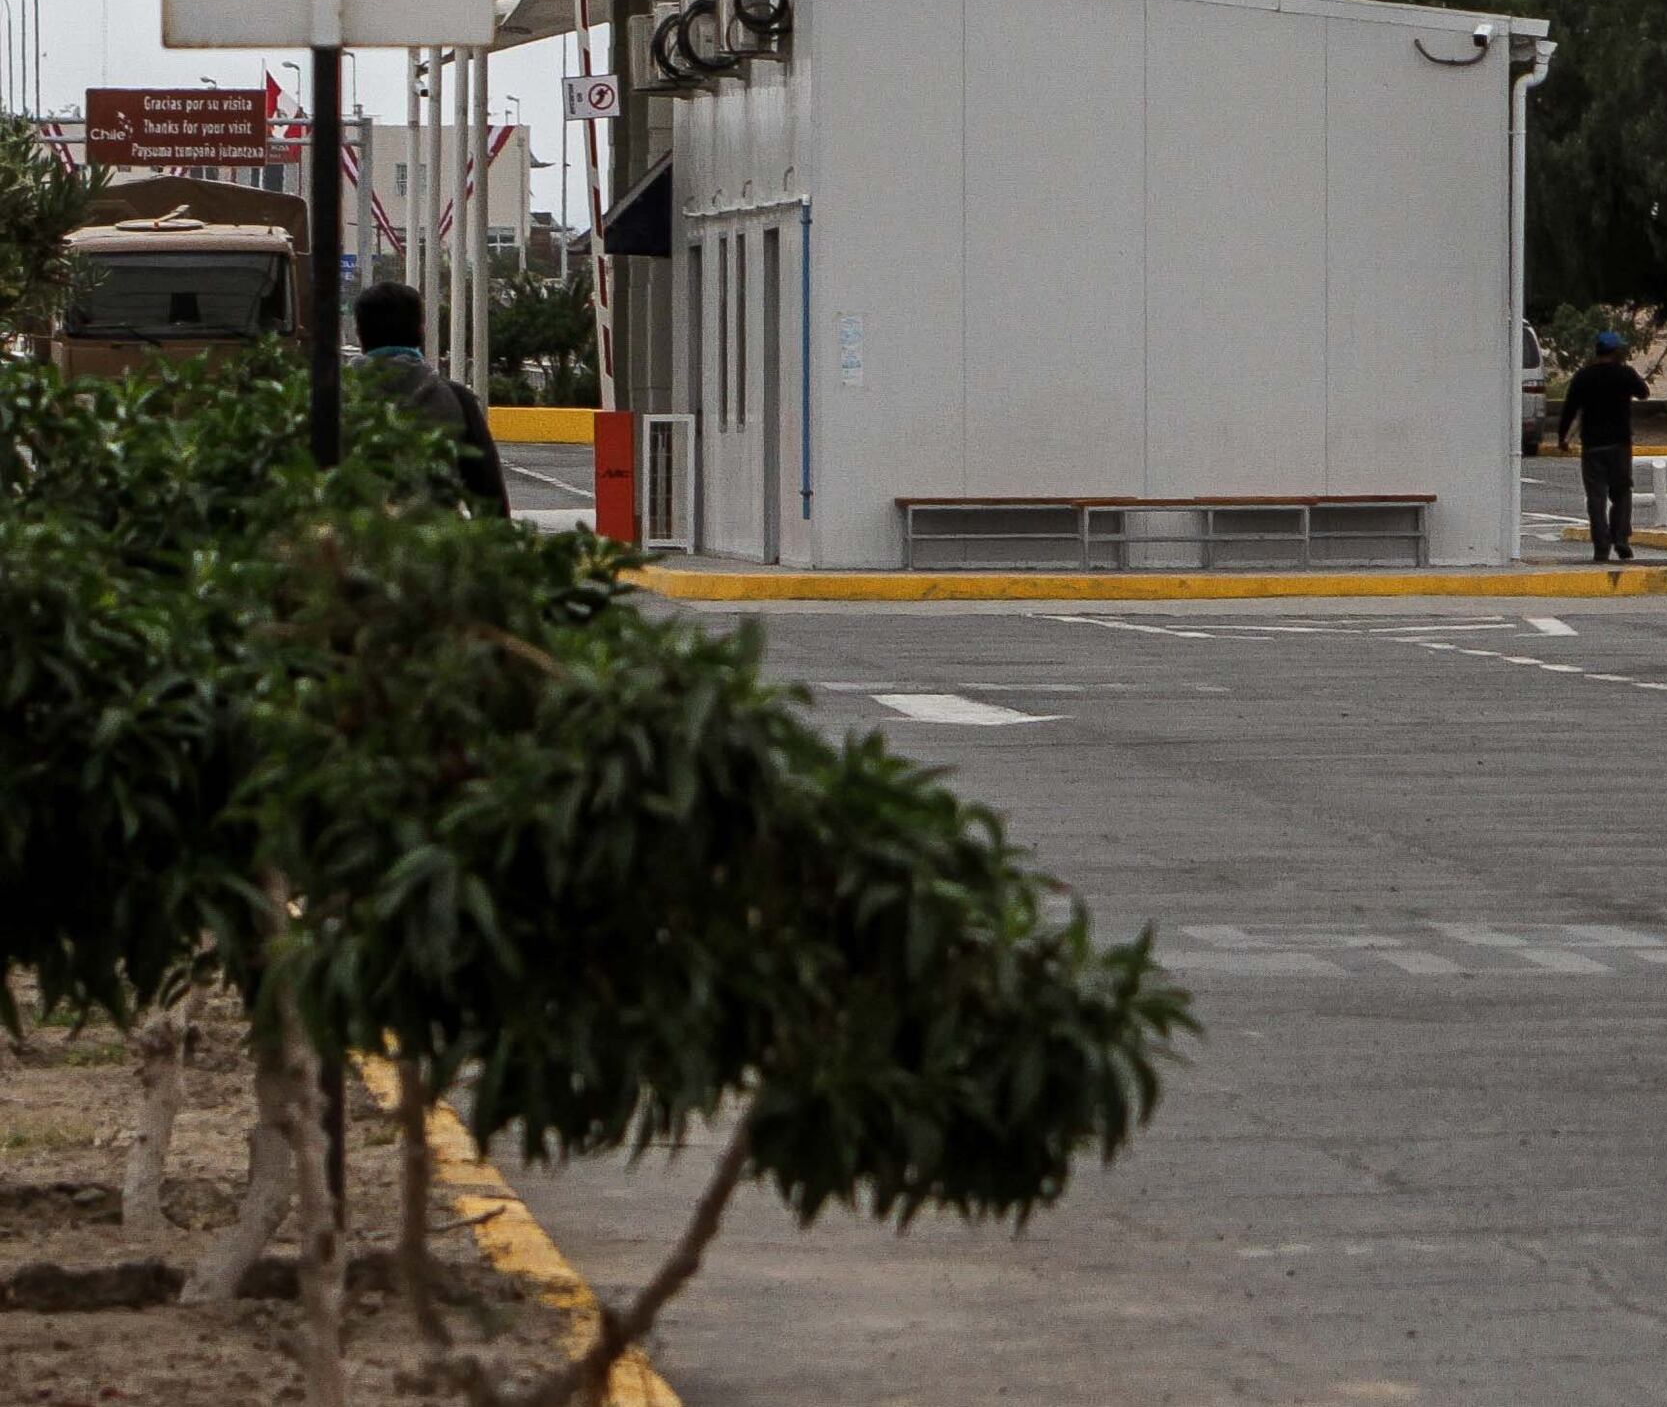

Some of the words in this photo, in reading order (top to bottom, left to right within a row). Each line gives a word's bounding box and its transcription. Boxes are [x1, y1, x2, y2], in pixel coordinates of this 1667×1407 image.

[143, 95, 182, 111] Gracias
[185, 99, 204, 113] por
[207, 99, 220, 111] su
[223, 95, 253, 111] visita
[89, 127, 127, 141] Chile
[143, 118, 180, 135] Thanks
[183, 119, 199, 135] for
[201, 122, 226, 137] your
[228, 119, 252, 135] visit
